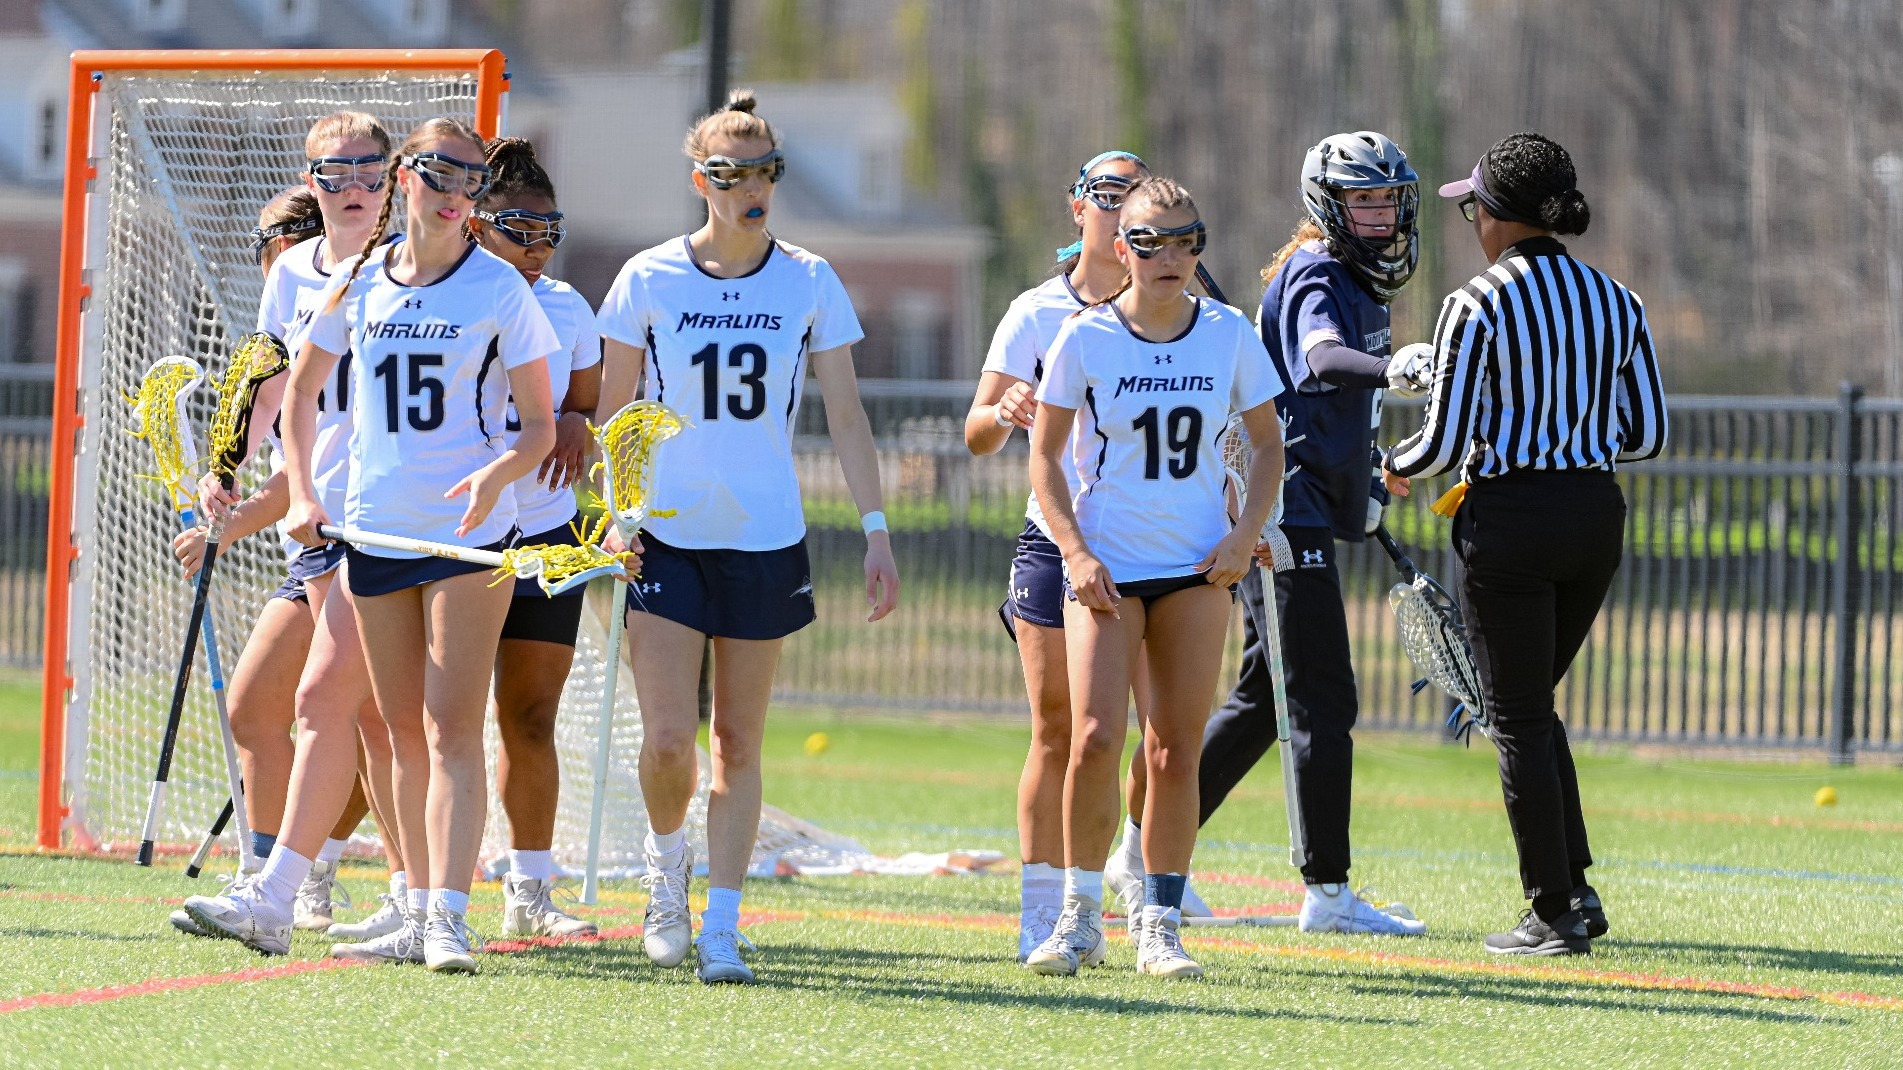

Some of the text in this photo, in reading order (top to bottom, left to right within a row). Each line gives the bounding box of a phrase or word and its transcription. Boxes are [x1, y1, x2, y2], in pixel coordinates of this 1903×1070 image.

[361, 321, 463, 344] MARLINS
[674, 312, 784, 333] MARLINS
[374, 353, 445, 433] 15
[690, 341, 768, 421] 13
[1113, 375, 1215, 400] MARLINS
[1132, 406, 1203, 481] 19
